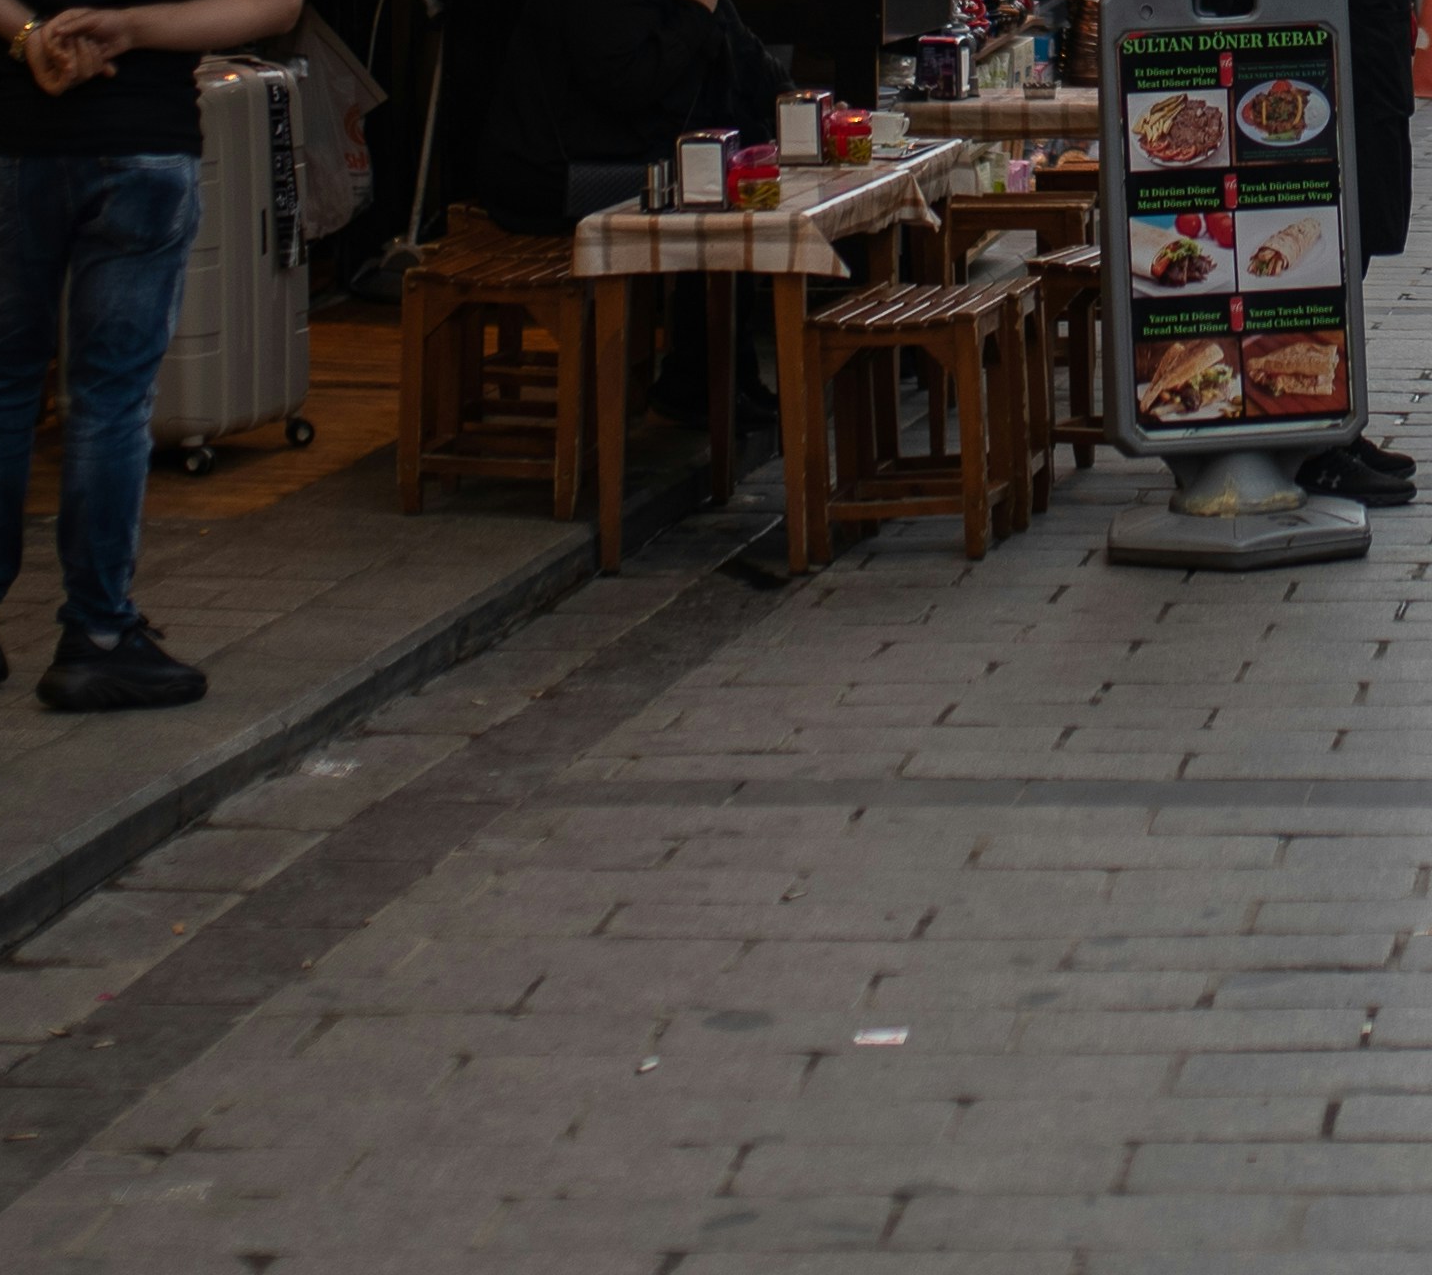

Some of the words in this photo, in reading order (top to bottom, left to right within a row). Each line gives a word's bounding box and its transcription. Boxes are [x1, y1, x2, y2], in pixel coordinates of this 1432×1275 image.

[1122, 35, 1194, 55] SULTAN
[1199, 30, 1264, 51] DÖNER
[1268, 29, 1329, 48] KEBAP
[1134, 67, 1145, 78] Et
[1146, 65, 1175, 77] Döner
[1177, 64, 1218, 77] Porsiyon
[1137, 77, 1161, 89] Meat
[1162, 76, 1191, 89] Döner
[1192, 76, 1216, 87] Plate
[1139, 188, 1152, 198] Et
[1153, 185, 1186, 197] Dürüm
[1187, 185, 1216, 195] Döner
[1240, 182, 1268, 193] Tavuk
[1269, 180, 1300, 192] Dürüm
[1302, 179, 1330, 189] Döner
[1138, 200, 1161, 210] Meat
[1163, 199, 1192, 210] Döner
[1194, 197, 1221, 209] Wrap
[1239, 193, 1276, 204] Chicken
[1277, 192, 1305, 202] Döner
[1306, 191, 1333, 203] Wrap
[1149, 314, 1178, 324] Yarım
[1180, 313, 1190, 322] Et
[1191, 311, 1221, 321] Döner
[1249, 308, 1276, 318] Yarım
[1277, 306, 1304, 316] Tavuk
[1306, 305, 1334, 315] Döner
[1143, 325, 1171, 336] Bread
[1173, 324, 1197, 335] Meat
[1199, 322, 1229, 333] Döner
[1246, 320, 1272, 330] Bread
[1274, 317, 1311, 328] Chicken
[1312, 315, 1340, 326] Döner
